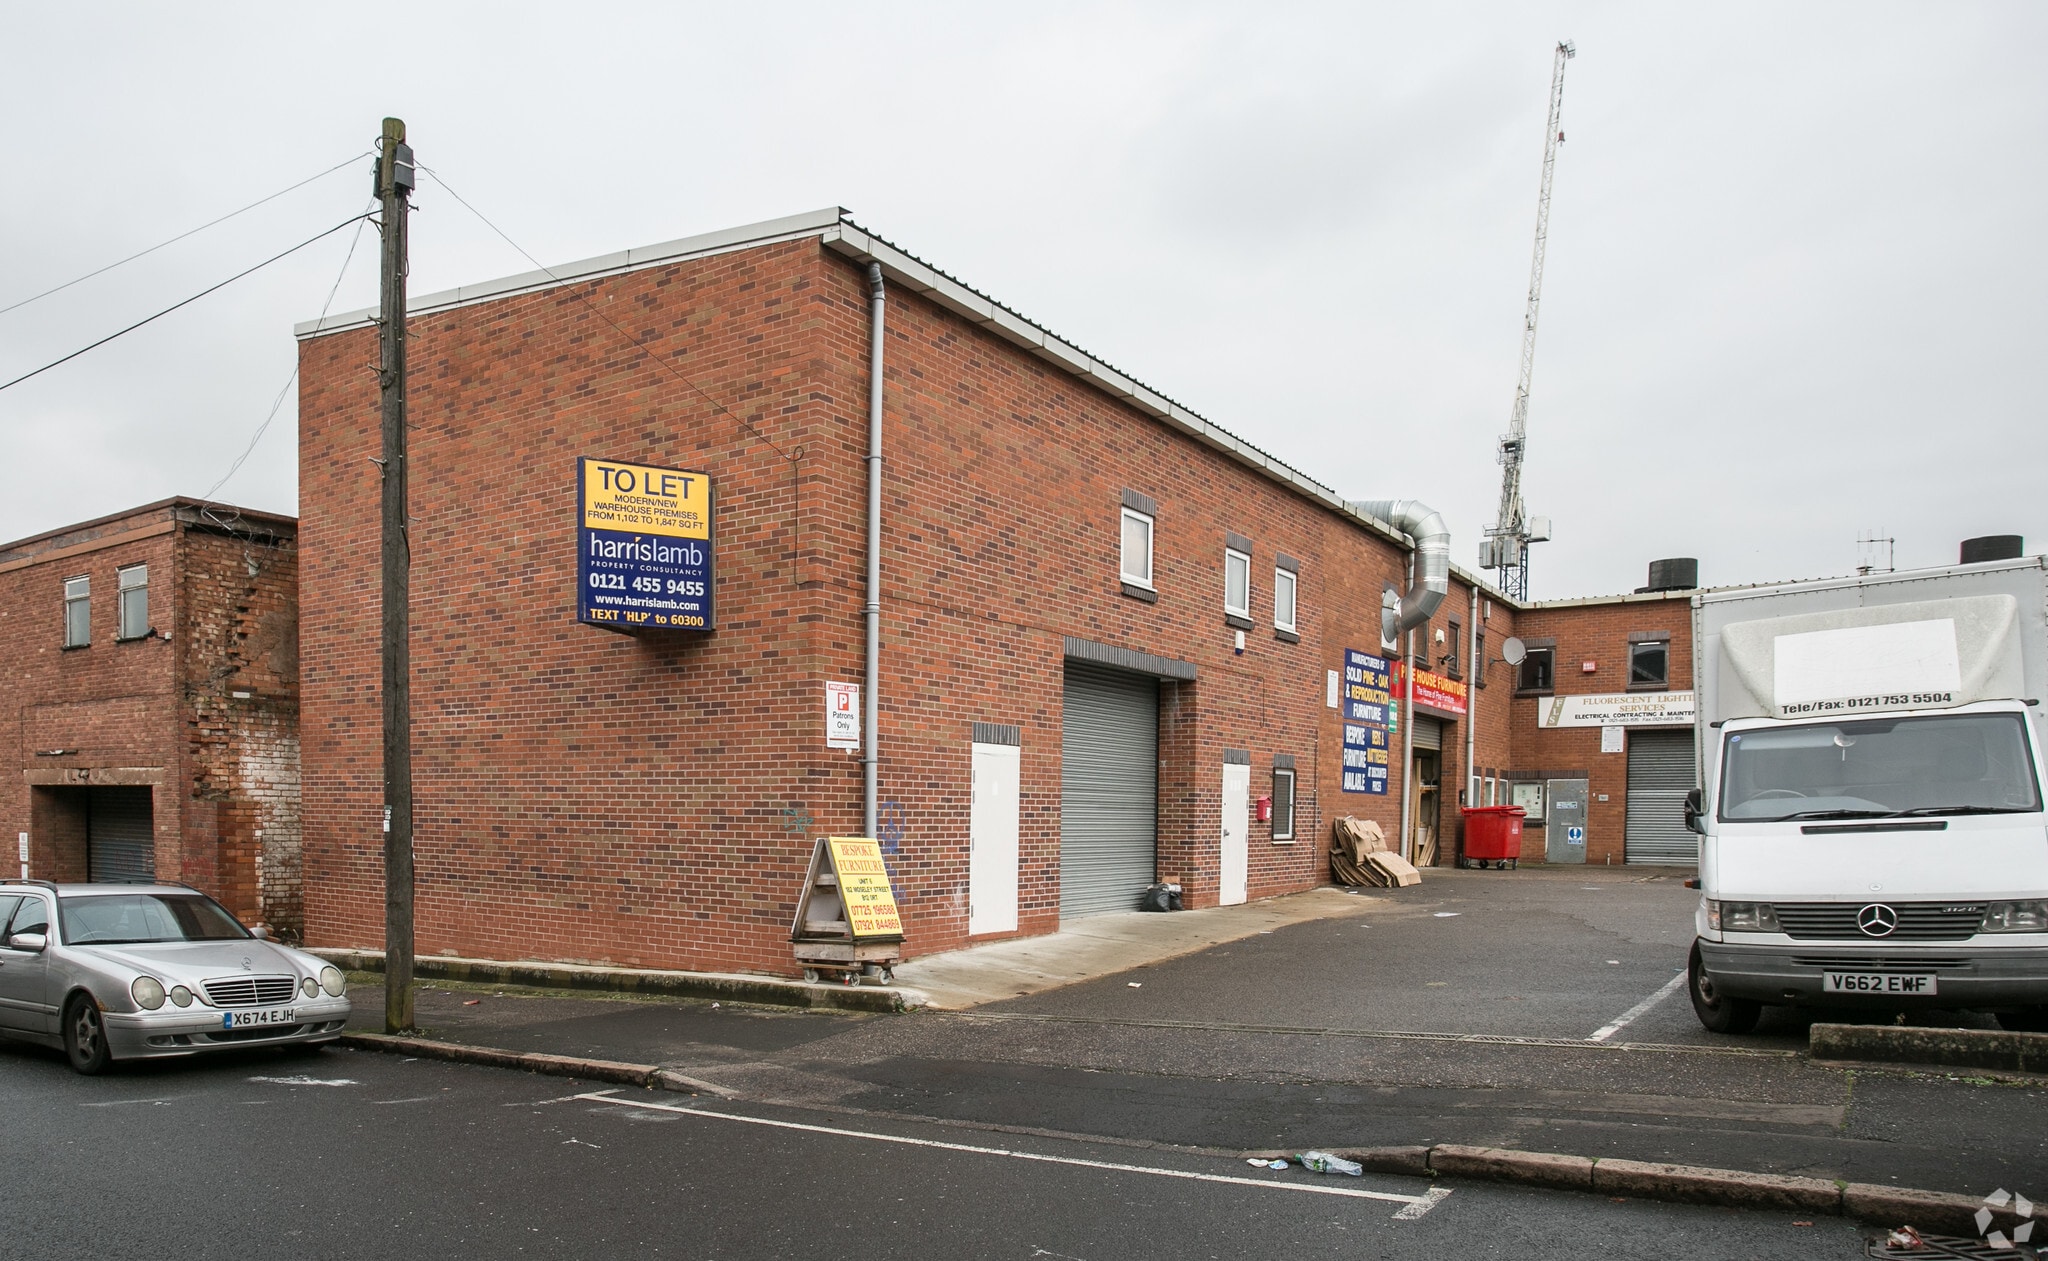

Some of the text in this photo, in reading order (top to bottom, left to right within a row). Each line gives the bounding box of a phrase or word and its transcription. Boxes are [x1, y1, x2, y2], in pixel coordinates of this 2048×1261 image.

[598, 466, 694, 499] TO LET
[614, 494, 678, 508] MODERN/NEW
[588, 510, 614, 520] FROM
[617, 513, 638, 522] 1,102
[640, 516, 652, 524] TO
[656, 518, 676, 526] 1,847
[678, 520, 690, 528] SQ
[594, 502, 698, 520] WAREHOUSE PREMISES
[591, 532, 702, 566] harrislamb
[591, 560, 702, 576] PROPERTY CONSULTANCY
[590, 573, 704, 596] 0121 455 9455
[596, 595, 700, 610] www.harrislamb.com
[590, 608, 619, 620] TEXT
[656, 614, 667, 624] to
[671, 615, 704, 626] 60300
[1346, 666, 1362, 682] SOLID
[1362, 670, 1375, 686] PINE
[1378, 674, 1388, 688] OAK
[1417, 670, 1436, 688] HOUSE
[1438, 677, 1466, 696] FURNITURE
[1346, 683, 1350, 698] &
[1352, 685, 1388, 705] REPRODUCTION
[1583, 694, 1695, 706] FLUORESCENT LIGHTI
[1353, 702, 1382, 720] FURNITURE
[1619, 704, 1666, 712] SERVICES
[1782, 693, 1952, 714] Tele/Fax: 0121 753 5504
[832, 710, 854, 720] Patrons
[837, 721, 850, 730] Only
[1346, 725, 1366, 746] BESPOKE
[1344, 748, 1366, 768] FURNITURE
[840, 844, 874, 856] BESPOKE
[838, 860, 884, 871] FURNITURE
[851, 906, 871, 916] 07725
[854, 920, 874, 930] 07921
[1832, 975, 1927, 992] V662 EWF
[234, 1009, 295, 1025] X674 EJH
